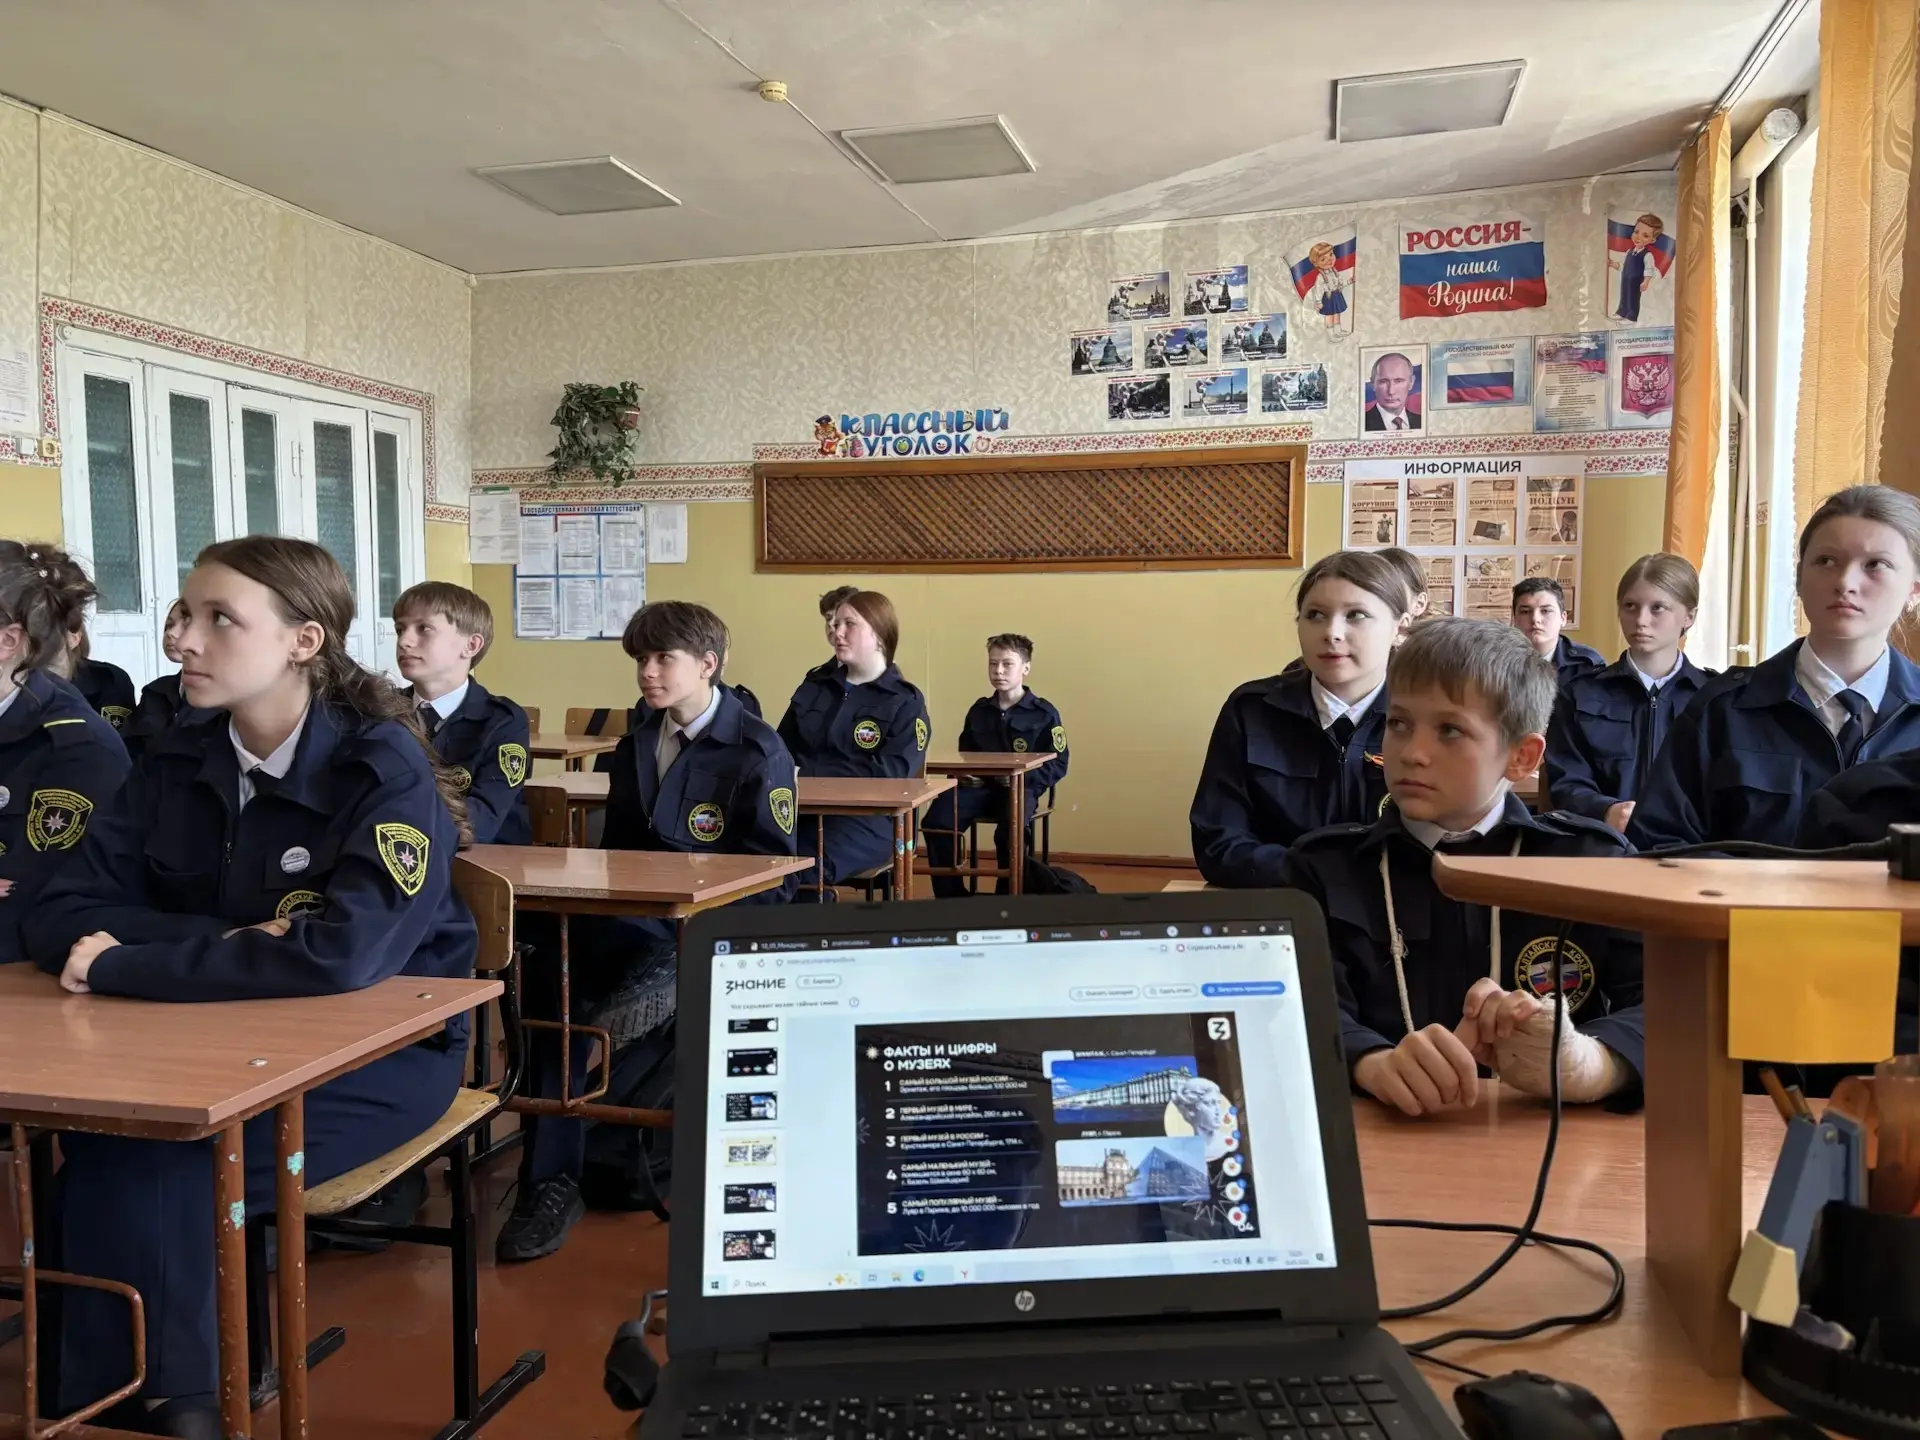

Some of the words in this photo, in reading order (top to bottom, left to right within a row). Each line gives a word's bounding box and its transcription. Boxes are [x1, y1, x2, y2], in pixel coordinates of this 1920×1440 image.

[1406, 221, 1531, 252] РОССИЯ-
[1446, 259, 1501, 277] наша
[1427, 276, 1514, 313] Родина!
[1446, 344, 1499, 352] ГОСУДАРСТВЕННЫЙ
[841, 407, 1009, 436] КЛАССНЫЙ
[863, 433, 971, 457] УГОЛОК
[1404, 461, 1522, 475] ИНФОРМАЦИЯ
[1529, 497, 1575, 505] ПОДКУП
[524, 506, 576, 514] ГОСУДАРСТВЕННАЯ
[1519, 940, 1558, 971] АЛТАЙСКИ
[1569, 948, 1590, 971] КРАЙ
[883, 1045, 931, 1058] ФАКТЫ
[934, 1044, 945, 1056] И
[948, 1042, 997, 1056] ЦИФРЫ
[883, 1060, 895, 1071] О
[898, 1058, 951, 1071] МУЗЕЯХ
[884, 1080, 891, 1092] 1
[885, 1107, 896, 1119] 2
[885, 1135, 896, 1147] 3
[956, 1132, 984, 1140] РОССИИ
[901, 1162, 927, 1171] САМЫЙ
[928, 1160, 968, 1170] МАЛЕНЬКИЙ
[968, 1159, 991, 1168] МУЗЕЙ
[886, 1169, 898, 1181] 4
[901, 1198, 928, 1208] САМЫЙ
[974, 1195, 997, 1204] МУЗЕЙ
[887, 1202, 897, 1214] 5
